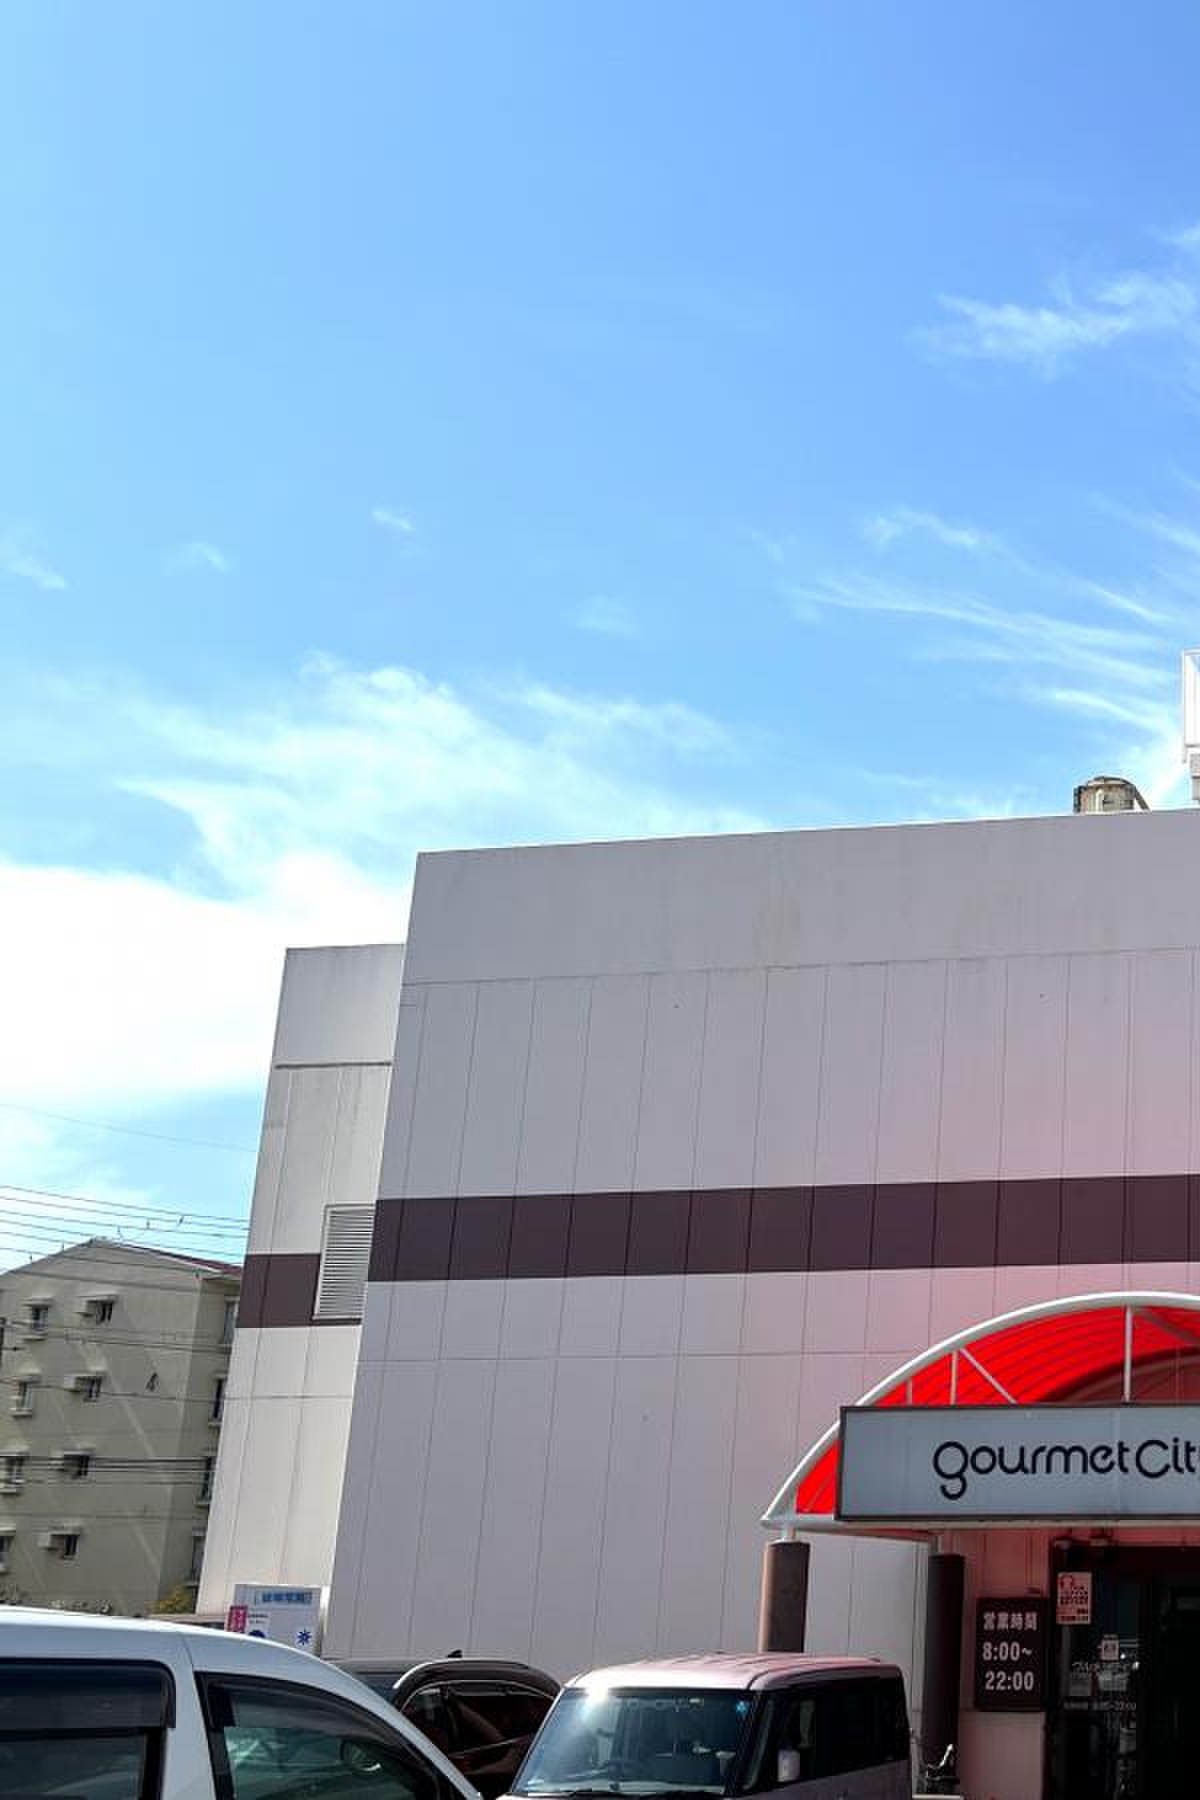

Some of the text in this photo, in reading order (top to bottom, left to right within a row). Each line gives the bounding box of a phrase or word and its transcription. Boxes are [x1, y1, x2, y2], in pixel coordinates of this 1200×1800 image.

[983, 1611, 1038, 1631] 営業時間
[985, 1671, 1035, 1691] 22:00
